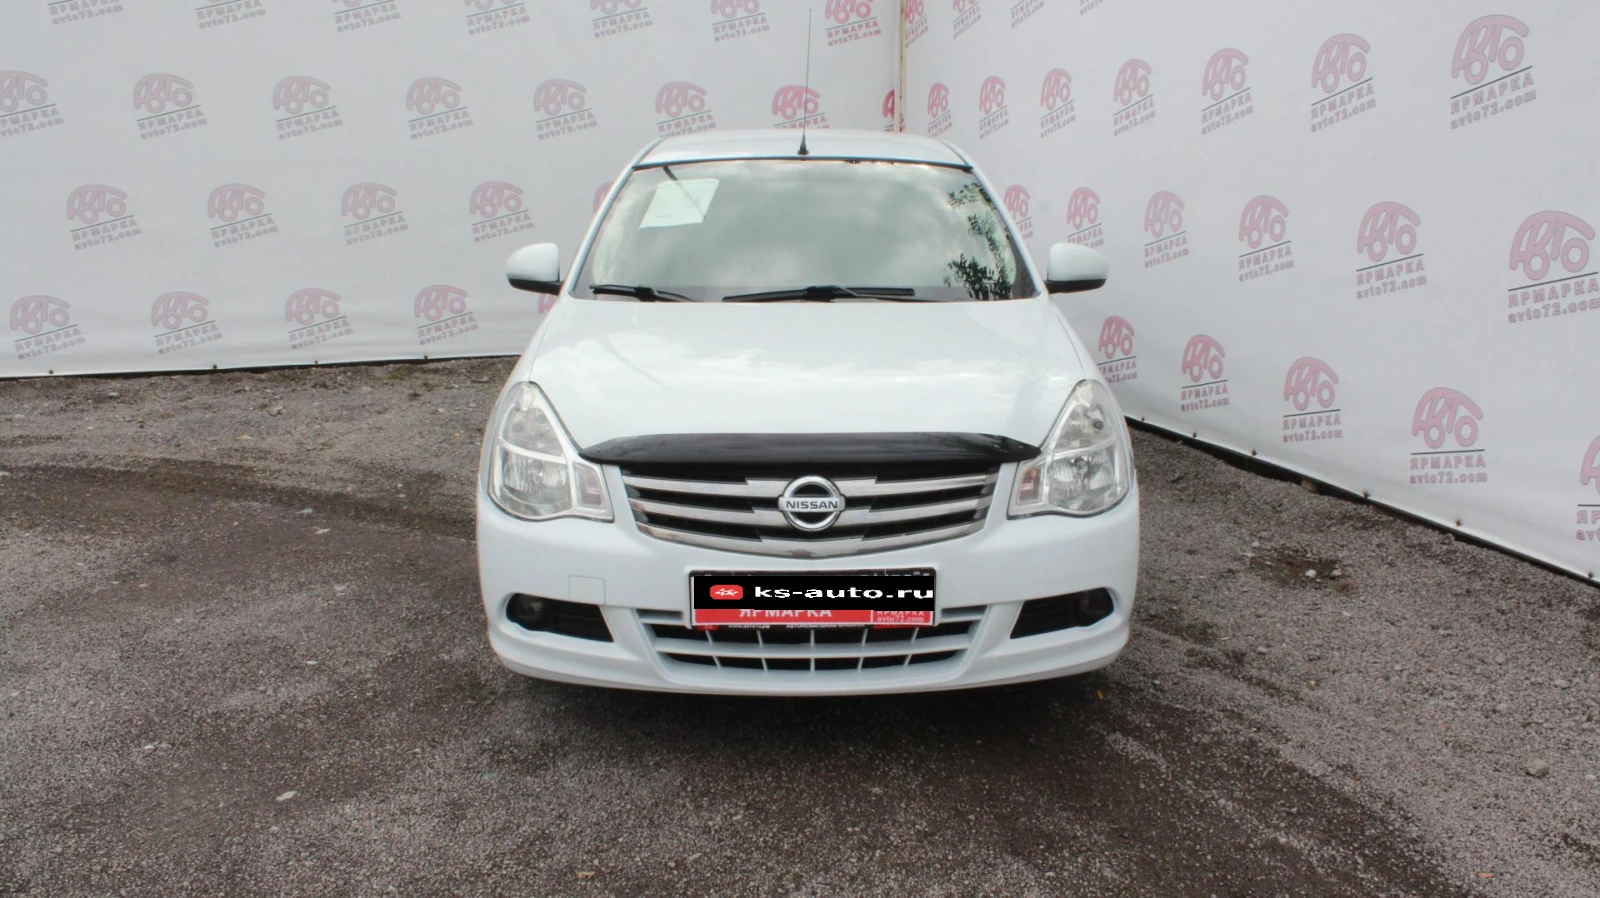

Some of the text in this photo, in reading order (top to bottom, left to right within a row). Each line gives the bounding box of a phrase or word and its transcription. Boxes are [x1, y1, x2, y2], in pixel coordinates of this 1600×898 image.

[1310, 83, 1374, 120] ЯРМАРКА
[1450, 72, 1534, 115] ЯРМАРКА
[0, 107, 60, 127] РМАРКА
[1311, 98, 1376, 132] avto72.com
[1450, 90, 1536, 130] avto72.com
[1238, 246, 1292, 270] ЯРМАРКА
[1239, 260, 1294, 282] avto72.com
[1356, 258, 1424, 286] ЯРМАРКА
[1356, 275, 1427, 300] avto72.com
[1508, 278, 1600, 308] ЯРМАРКА
[1508, 297, 1600, 324] avto72.com
[1181, 384, 1228, 400] ЯРМАРКА
[1181, 398, 1229, 412] avto72.com
[1283, 414, 1341, 430] ЯРМАРКА
[1282, 429, 1342, 443] avto72.com
[1410, 454, 1486, 470] ЯРМАРКА
[1410, 471, 1488, 484] avto72.com
[786, 501, 838, 509] NISSAN
[877, 615, 924, 623] avto72.com
